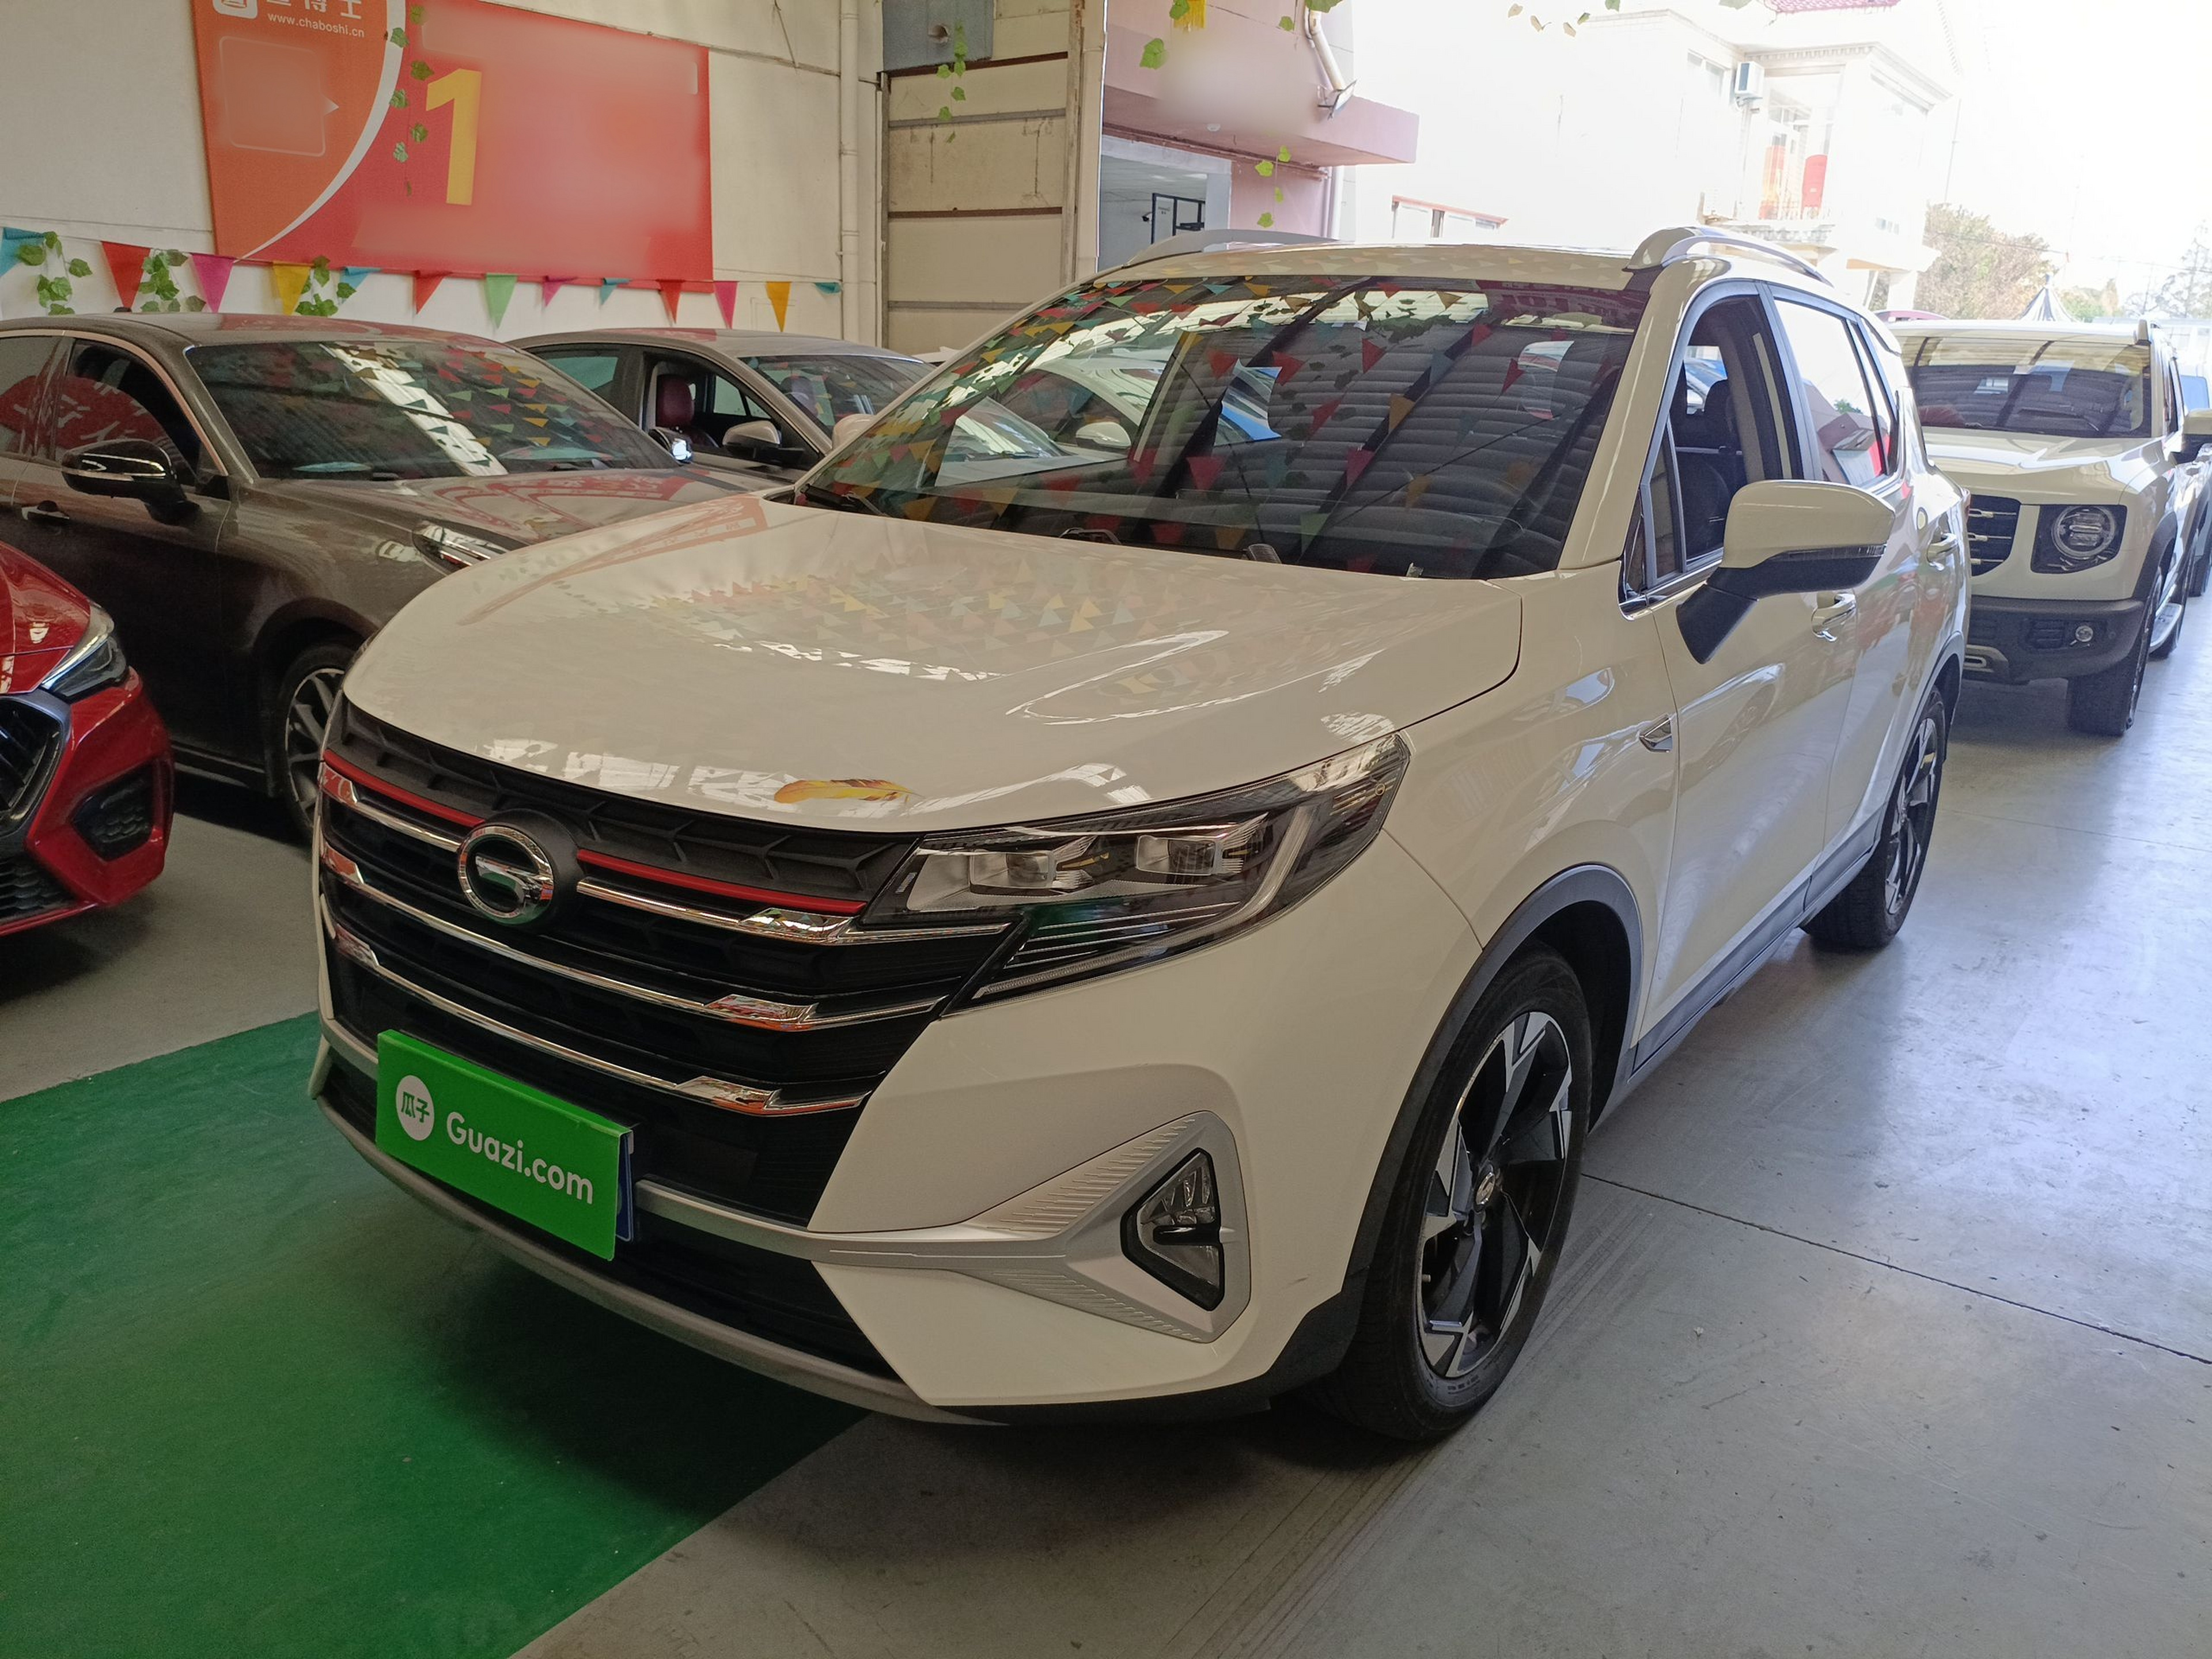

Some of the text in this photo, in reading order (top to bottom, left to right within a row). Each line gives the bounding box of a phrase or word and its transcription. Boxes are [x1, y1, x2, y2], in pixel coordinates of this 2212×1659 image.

[268, 13, 365, 37] www.chaboshi.cn
[401, 1091, 430, 1123] 瓜子
[446, 1112, 593, 1205] Guazi.com
